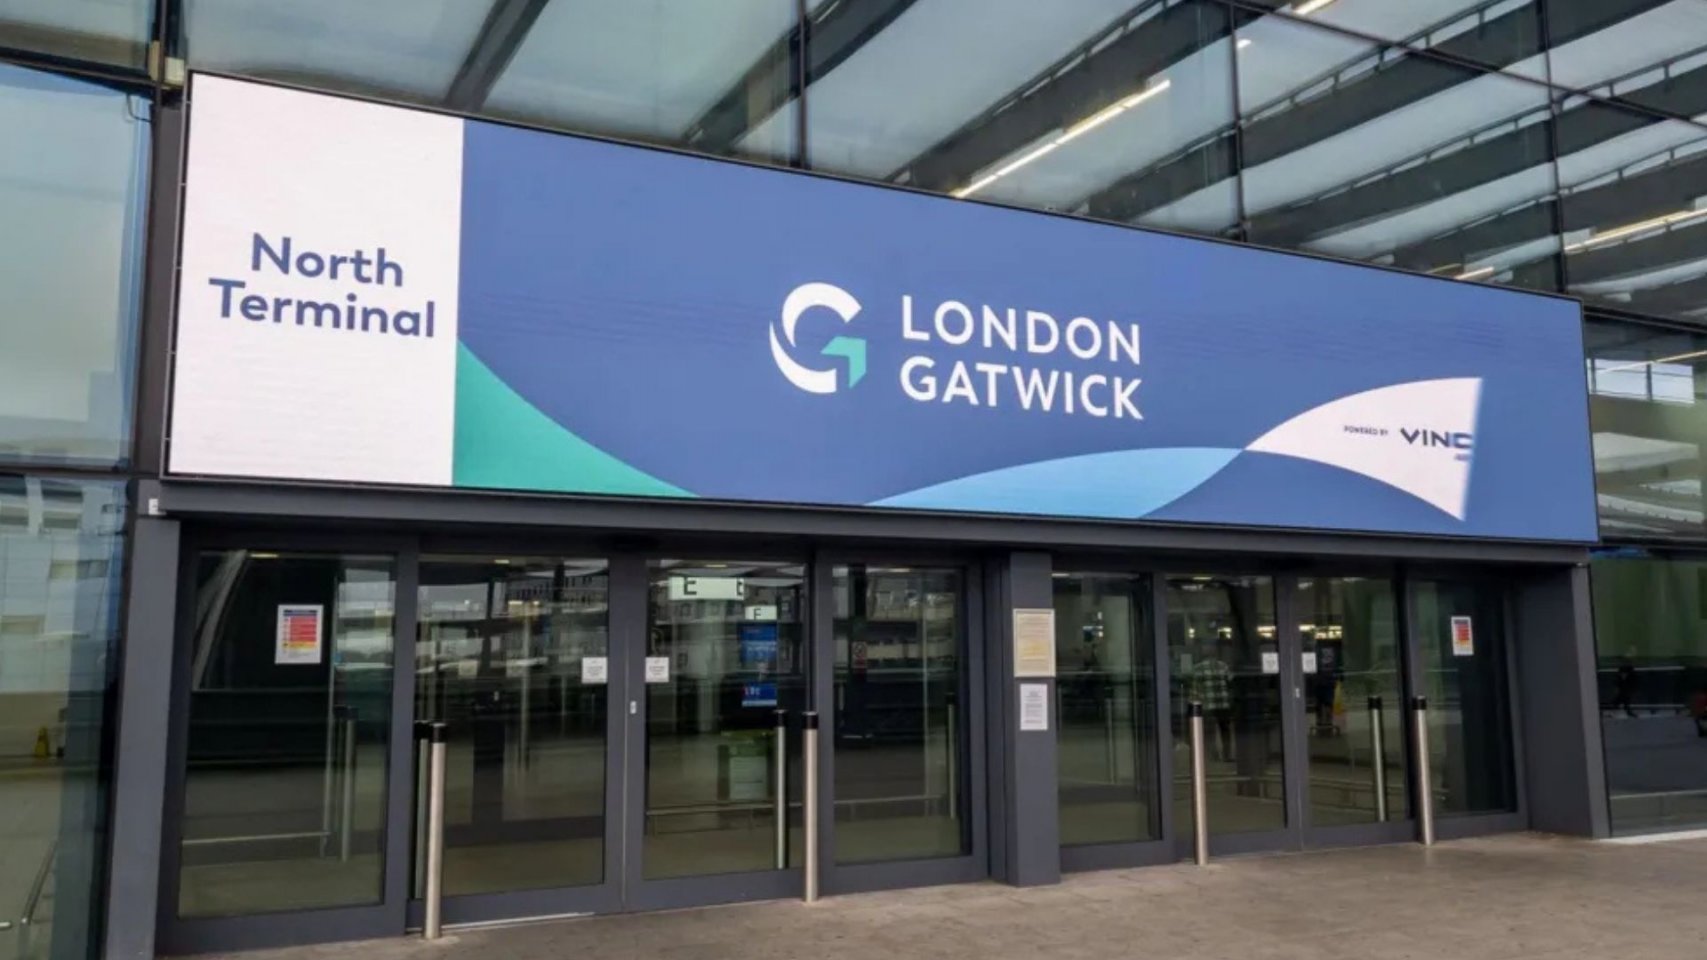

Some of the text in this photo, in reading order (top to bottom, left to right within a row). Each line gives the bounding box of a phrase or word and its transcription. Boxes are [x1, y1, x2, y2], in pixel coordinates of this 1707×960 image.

[252, 232, 403, 287] North
[208, 278, 435, 338] Terminal
[902, 295, 1140, 365] LONDON
[900, 355, 1143, 420] GATWICK
[1344, 424, 1388, 437] POWERED BY
